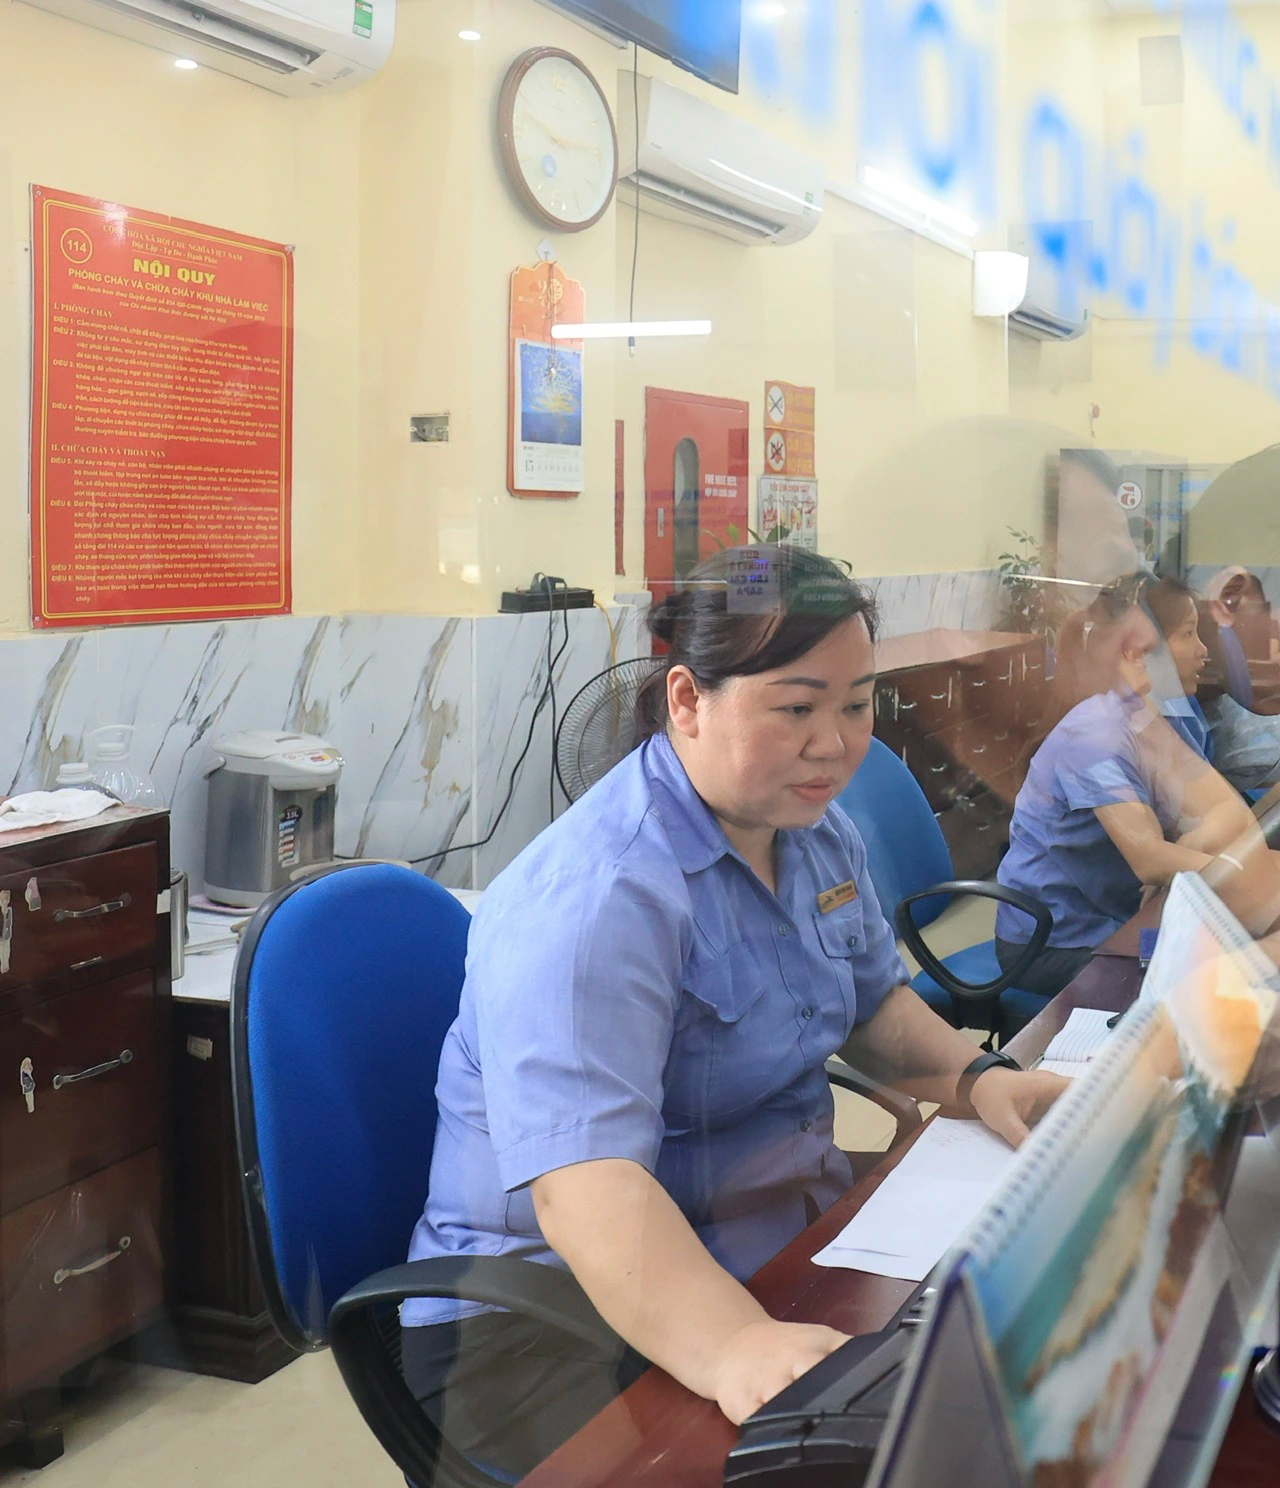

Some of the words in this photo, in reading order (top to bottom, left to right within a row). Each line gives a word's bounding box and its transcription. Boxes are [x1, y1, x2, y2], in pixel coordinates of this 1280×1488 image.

[67, 239, 86, 253] 114
[68, 265, 102, 282] PHÒNG
[103, 272, 129, 287] CHÁY
[131, 277, 143, 289] VÀ
[145, 280, 170, 294] CHỮA
[171, 284, 194, 298] CHÁY
[196, 291, 213, 302] KHU
[133, 255, 169, 280] NỘI
[177, 266, 215, 288] QUY
